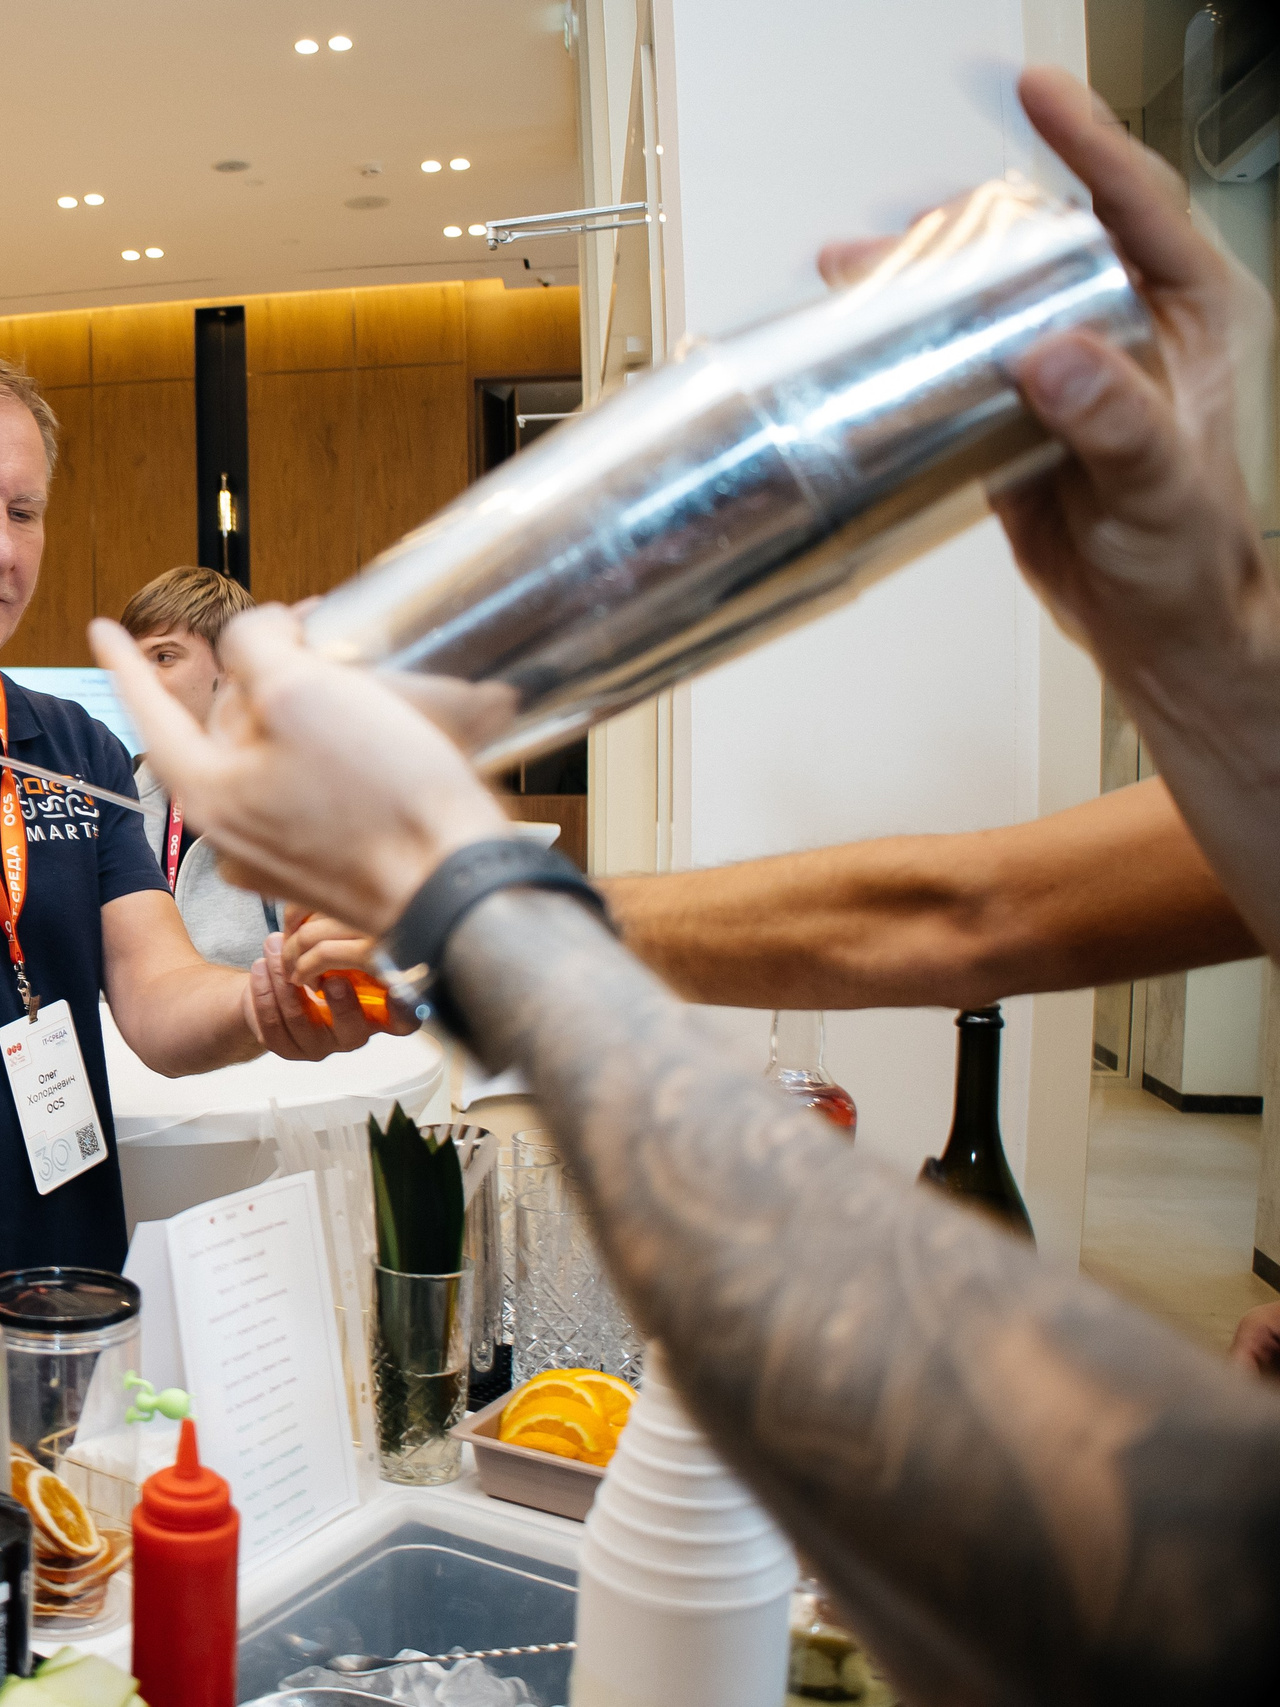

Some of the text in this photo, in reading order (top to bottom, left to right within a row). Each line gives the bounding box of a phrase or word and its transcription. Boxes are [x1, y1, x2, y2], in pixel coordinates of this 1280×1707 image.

[2, 792, 16, 827] OCS
[25, 821, 92, 842] MART
[170, 834, 179, 856] OCS
[38, 1069, 57, 1084] Олег
